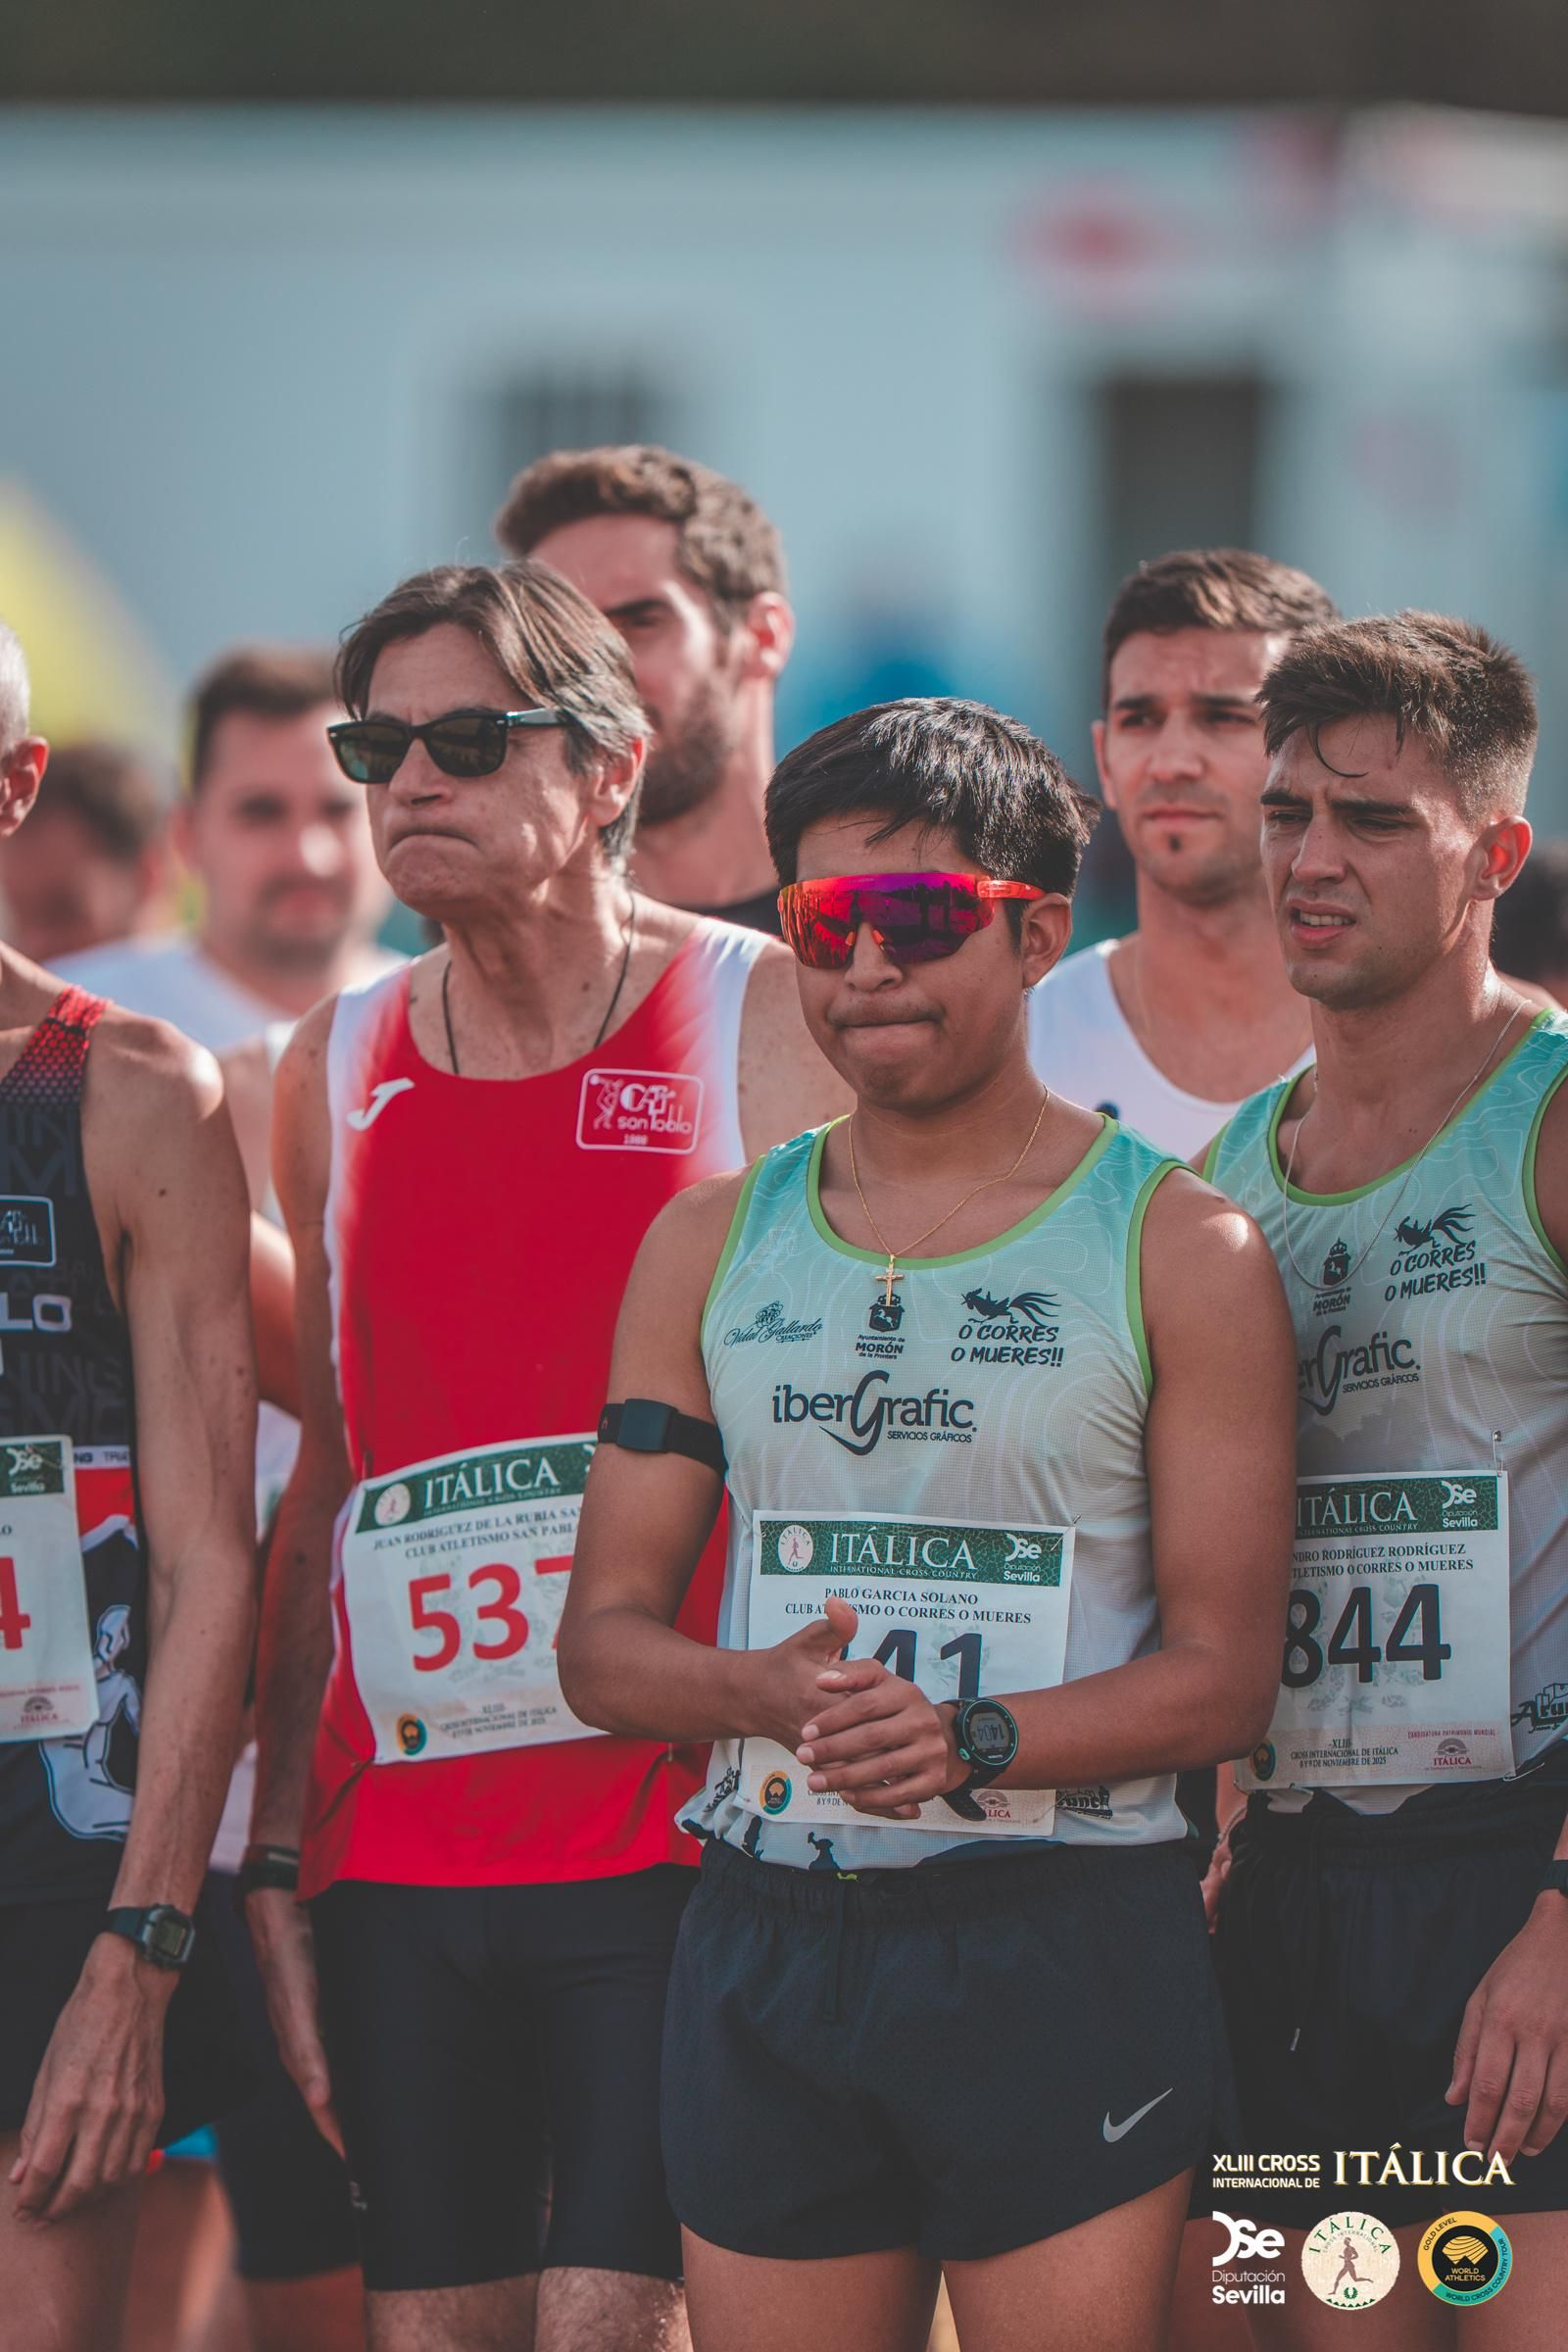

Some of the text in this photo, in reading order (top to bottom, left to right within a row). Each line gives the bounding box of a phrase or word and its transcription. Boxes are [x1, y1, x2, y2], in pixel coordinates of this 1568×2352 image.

[1390, 1240, 1476, 1276] O CORRES
[1385, 1262, 1487, 1301] O MUERES!!
[1313, 1294, 1351, 1310] MORÓN
[958, 1323, 1059, 1343] O CORRES
[856, 1342, 904, 1354] MORÓN
[951, 1346, 1064, 1367] O MUERES!!
[1343, 1373, 1419, 1393] SERVICIOS GRÁFICOS
[887, 1431, 972, 1443] SERVICIOS GRÁFICOS
[424, 1457, 561, 1509] ITÁLICA
[1297, 1487, 1418, 1527] ITÁLICA
[475, 1519, 490, 1531] DE
[494, 1516, 513, 1528] LA
[1379, 1522, 1418, 1532] COUNTRY
[1442, 1517, 1478, 1529] Sevilla
[405, 1522, 577, 1558] CLUB ATLETISMO SAN PABL
[831, 1526, 978, 1570] ITÁLICA
[1322, 1545, 1386, 1561] RODRÍGUEZ
[1389, 1543, 1467, 1557] RODRÍGUEZ
[830, 1565, 895, 1575] INTERNATIONAL
[932, 1570, 978, 1580] COUNTRY
[1348, 1564, 1355, 1575] O
[1357, 1562, 1401, 1575] CORRES
[1405, 1561, 1414, 1572] O
[1418, 1559, 1473, 1572] MUERES
[1004, 1571, 1040, 1583] Sevilla
[825, 1588, 978, 1605] PABLO GARCIA SOLANO
[785, 1603, 812, 1614] CLUB
[884, 1605, 895, 1616] O
[899, 1606, 956, 1620] CORRES
[959, 1609, 969, 1620] O
[973, 1610, 1031, 1624] MUERES
[1282, 1584, 1451, 1690] 844
[1434, 1755, 1472, 1766] ITÁLICA
